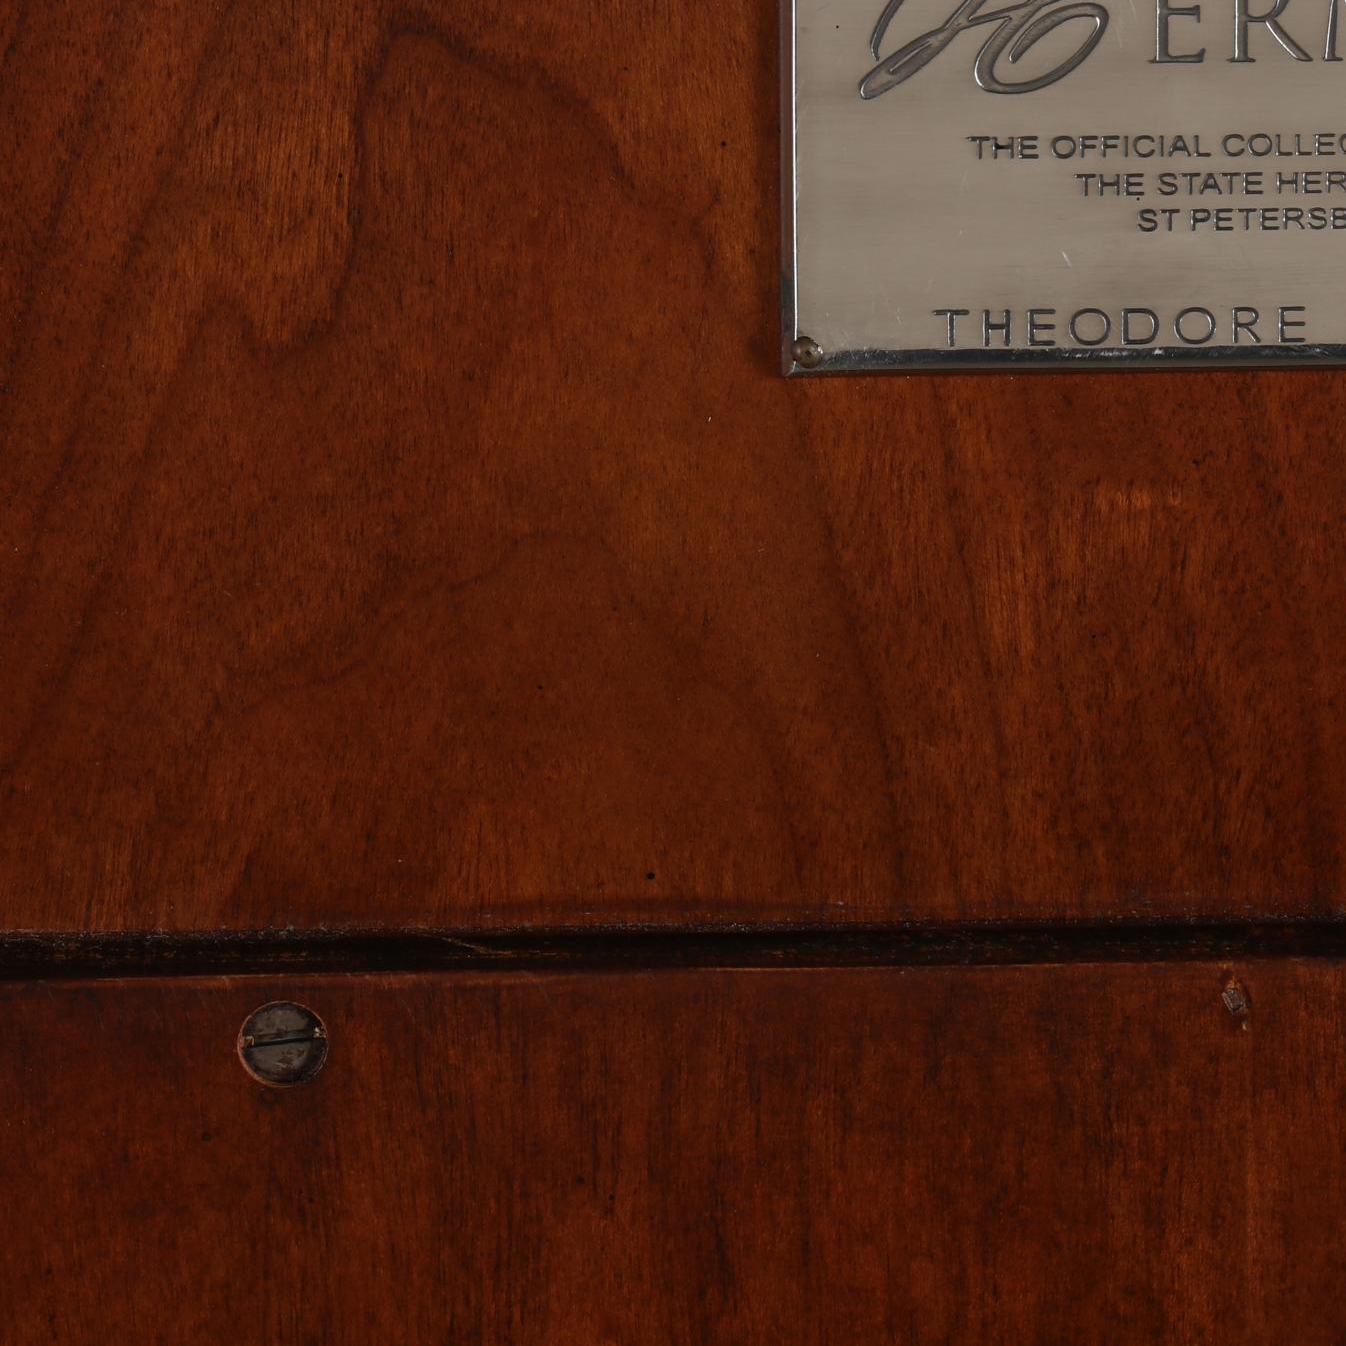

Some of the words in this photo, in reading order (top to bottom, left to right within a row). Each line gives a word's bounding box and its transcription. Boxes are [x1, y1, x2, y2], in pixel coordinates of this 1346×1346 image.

[968, 135, 1039, 161] THE
[1050, 133, 1212, 161] OFFICIAL
[1076, 172, 1145, 198] THE
[1157, 171, 1263, 197] STATE
[1138, 208, 1185, 233] ST
[932, 306, 1307, 347] THEODORE
